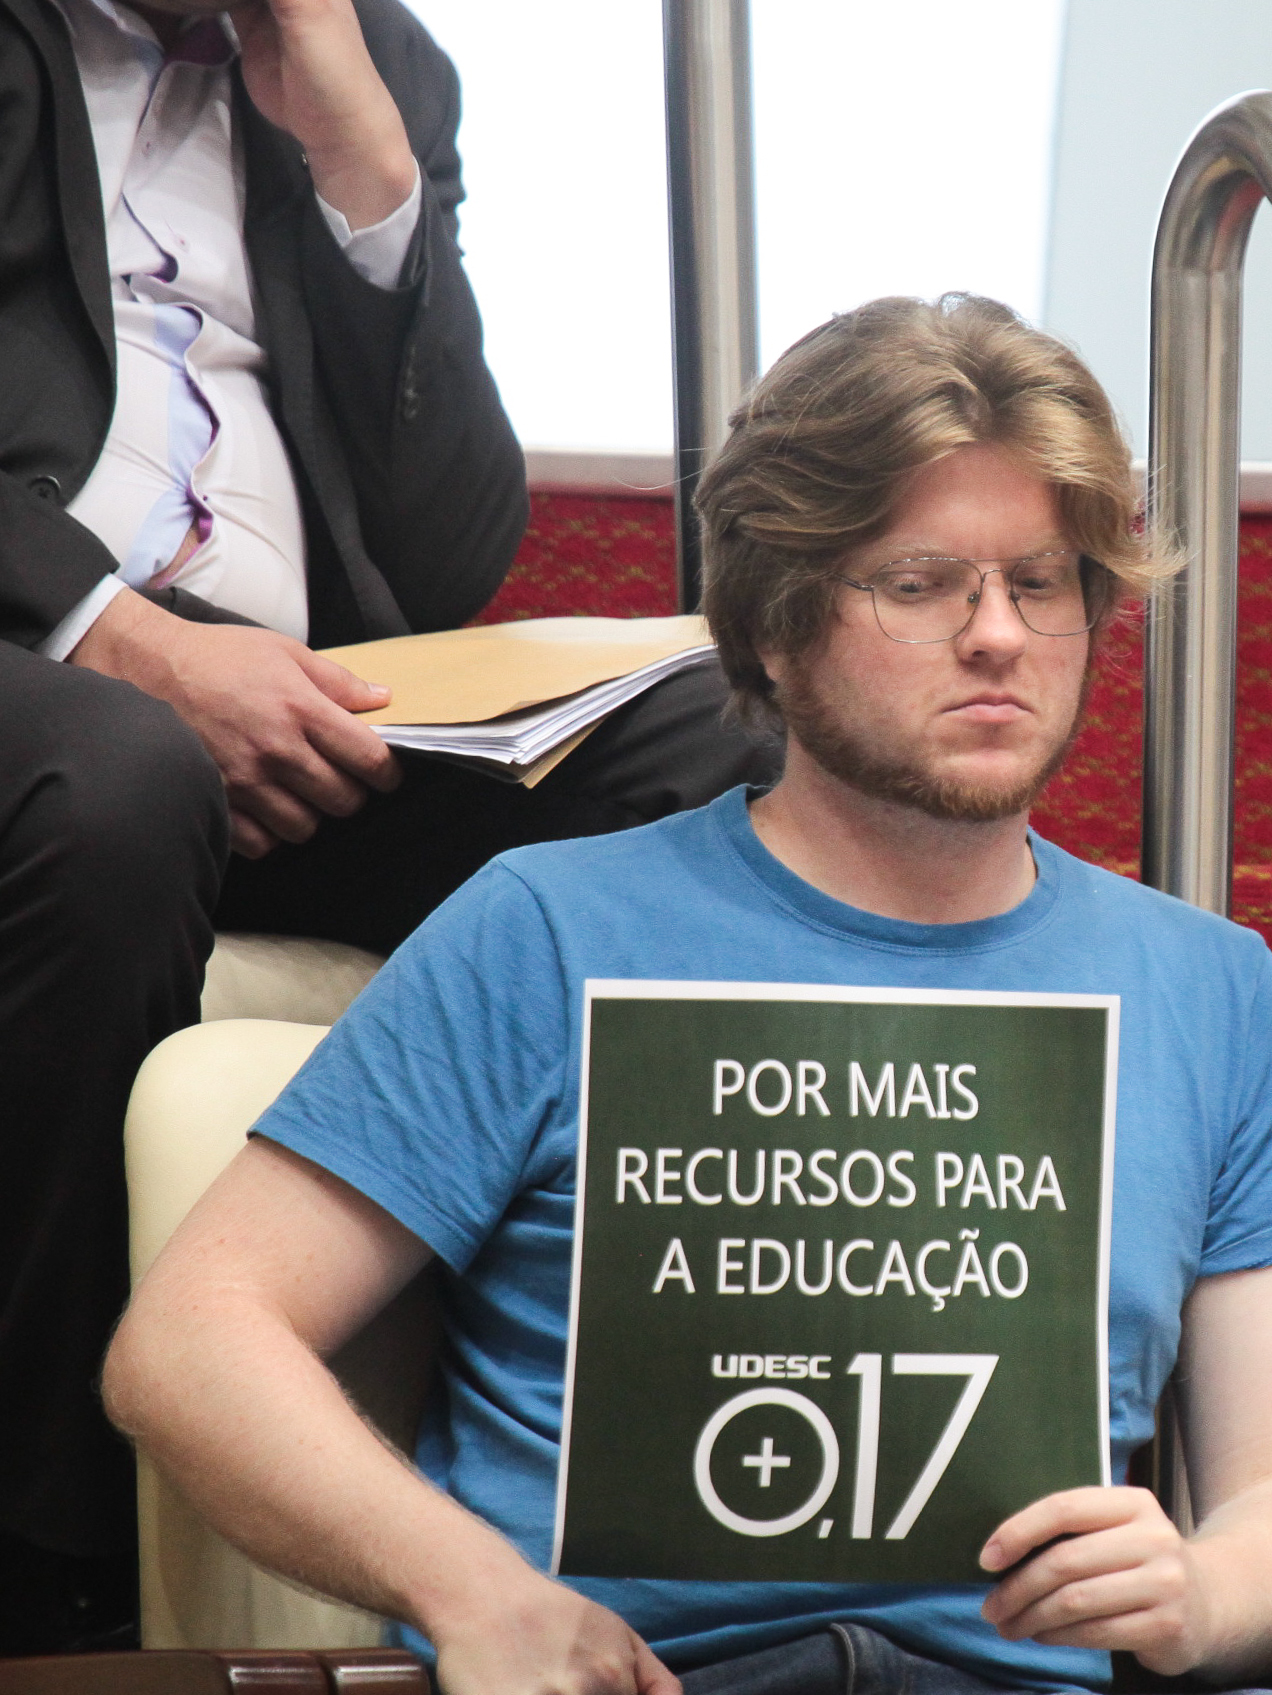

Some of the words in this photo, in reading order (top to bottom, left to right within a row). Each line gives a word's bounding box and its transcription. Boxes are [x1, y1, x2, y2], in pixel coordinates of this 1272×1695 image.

[712, 1059, 830, 1117] POR
[849, 1061, 979, 1120] MAIS
[616, 1147, 916, 1207] RECURSOS
[936, 1153, 1067, 1211] PARA
[652, 1238, 696, 1294] A
[717, 1229, 1029, 1312] EDUCAÇÃO
[711, 1354, 831, 1379] UDESC
